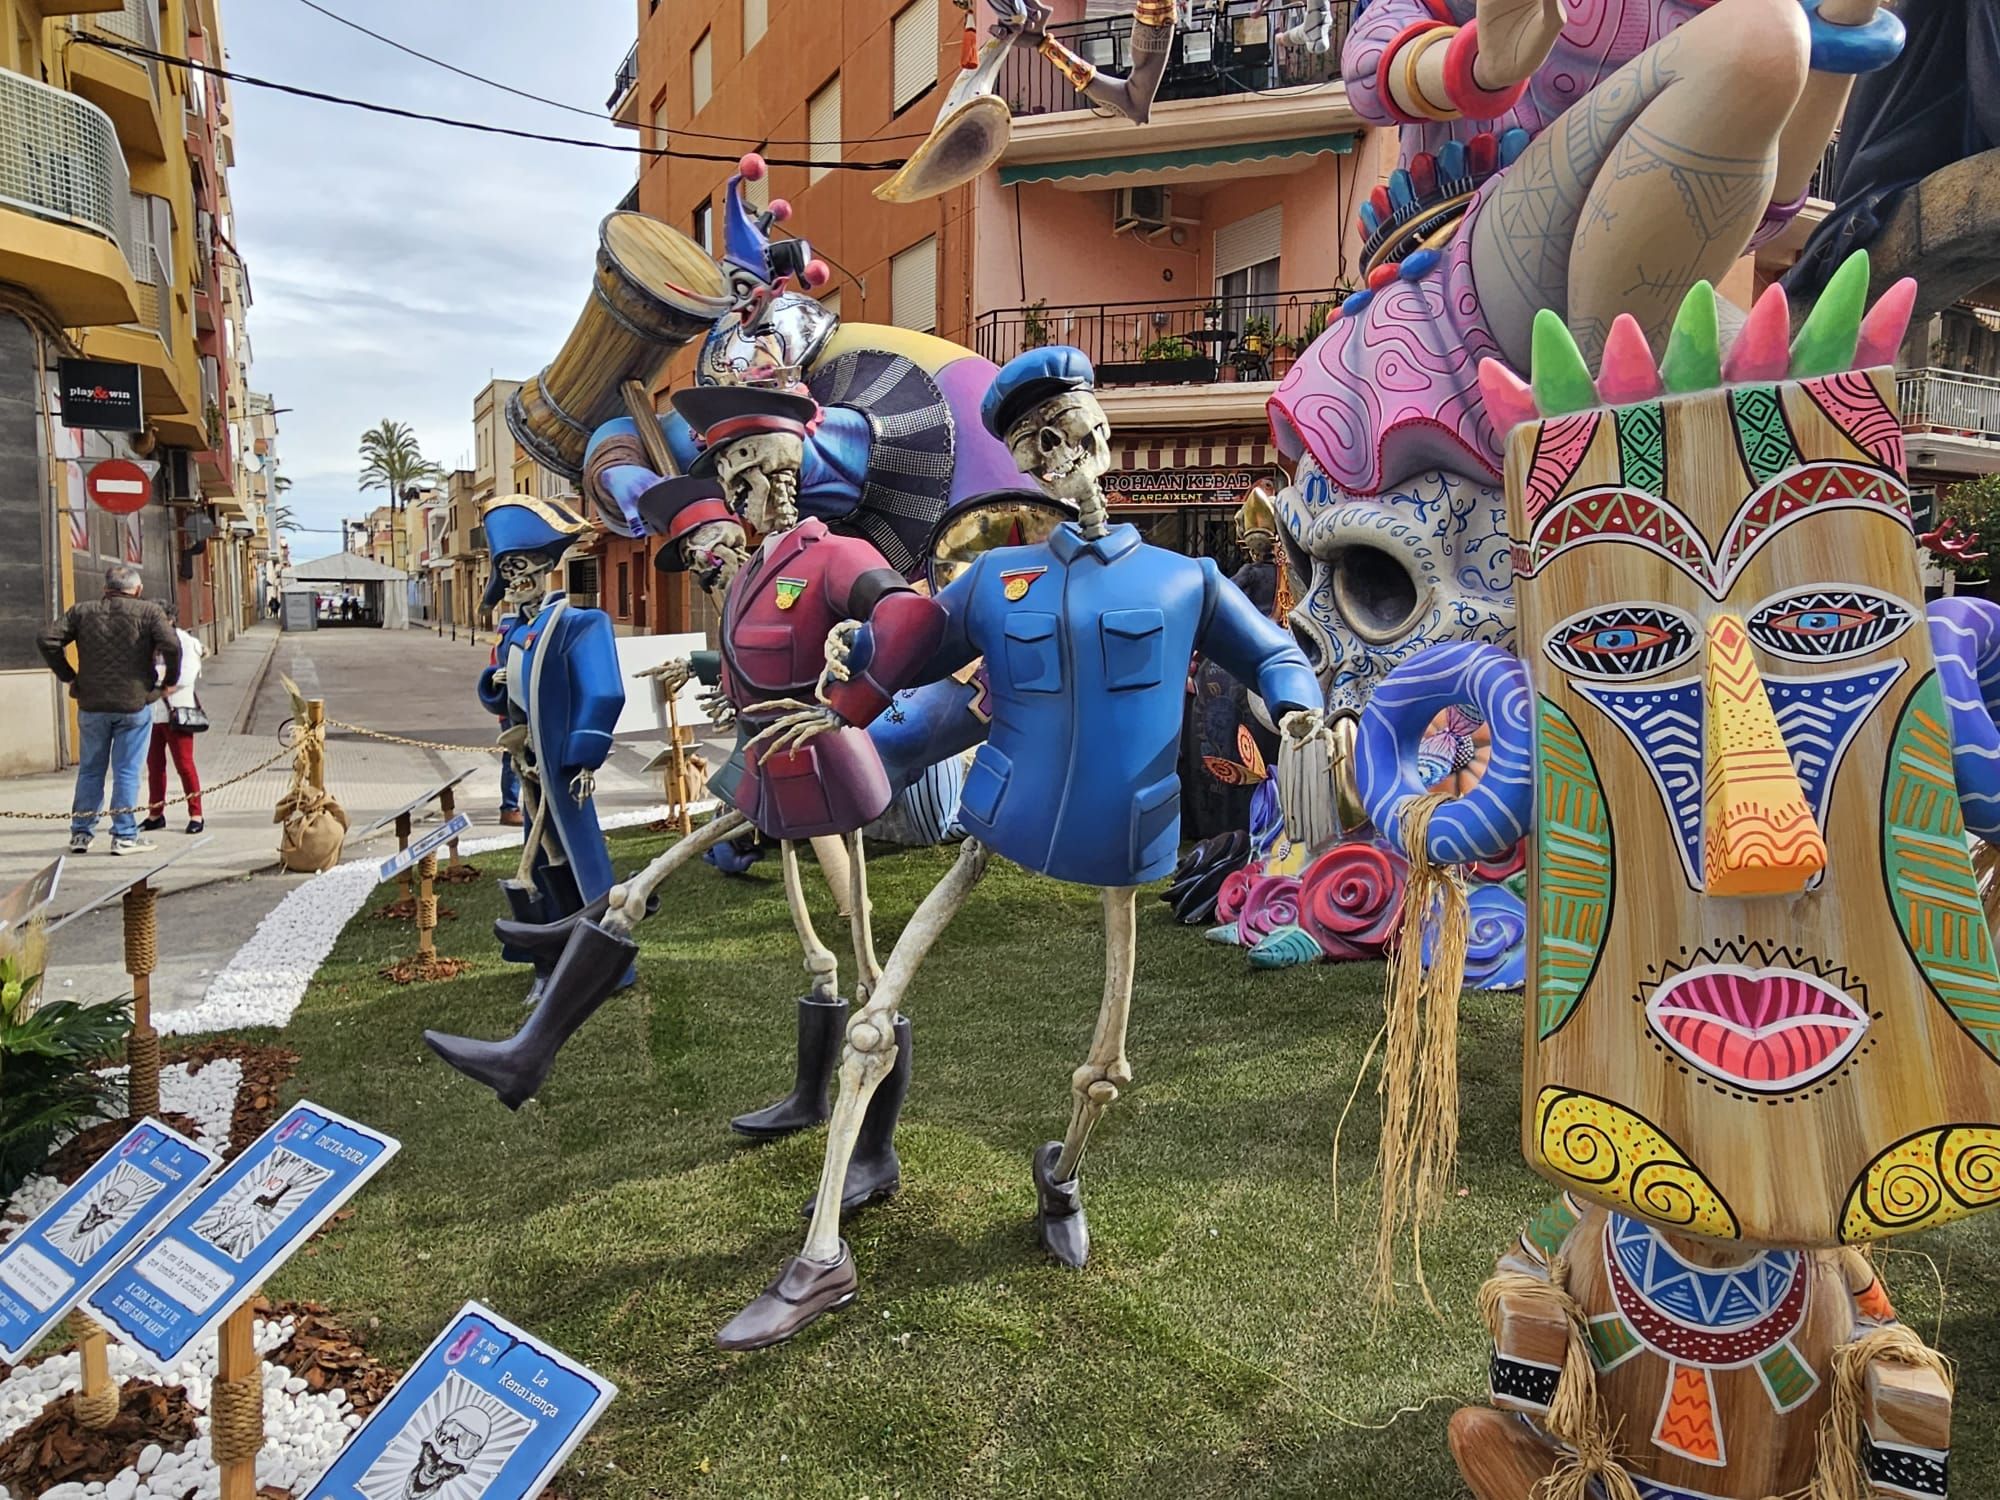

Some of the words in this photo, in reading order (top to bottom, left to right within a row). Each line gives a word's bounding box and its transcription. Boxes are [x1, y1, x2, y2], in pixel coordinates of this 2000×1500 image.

[69, 386, 130, 399] play&win
[1104, 474, 1184, 491] ROHAAN
[1187, 474, 1251, 490] KEBAB
[1132, 493, 1203, 501] CARCAIXENT
[315, 1134, 368, 1166] DICTA-DURA
[262, 1175, 283, 1191] NO
[124, 1282, 136, 1292] A
[130, 1285, 151, 1303] CADA
[532, 1369, 549, 1387] La
[497, 1371, 559, 1418] Renaixença
